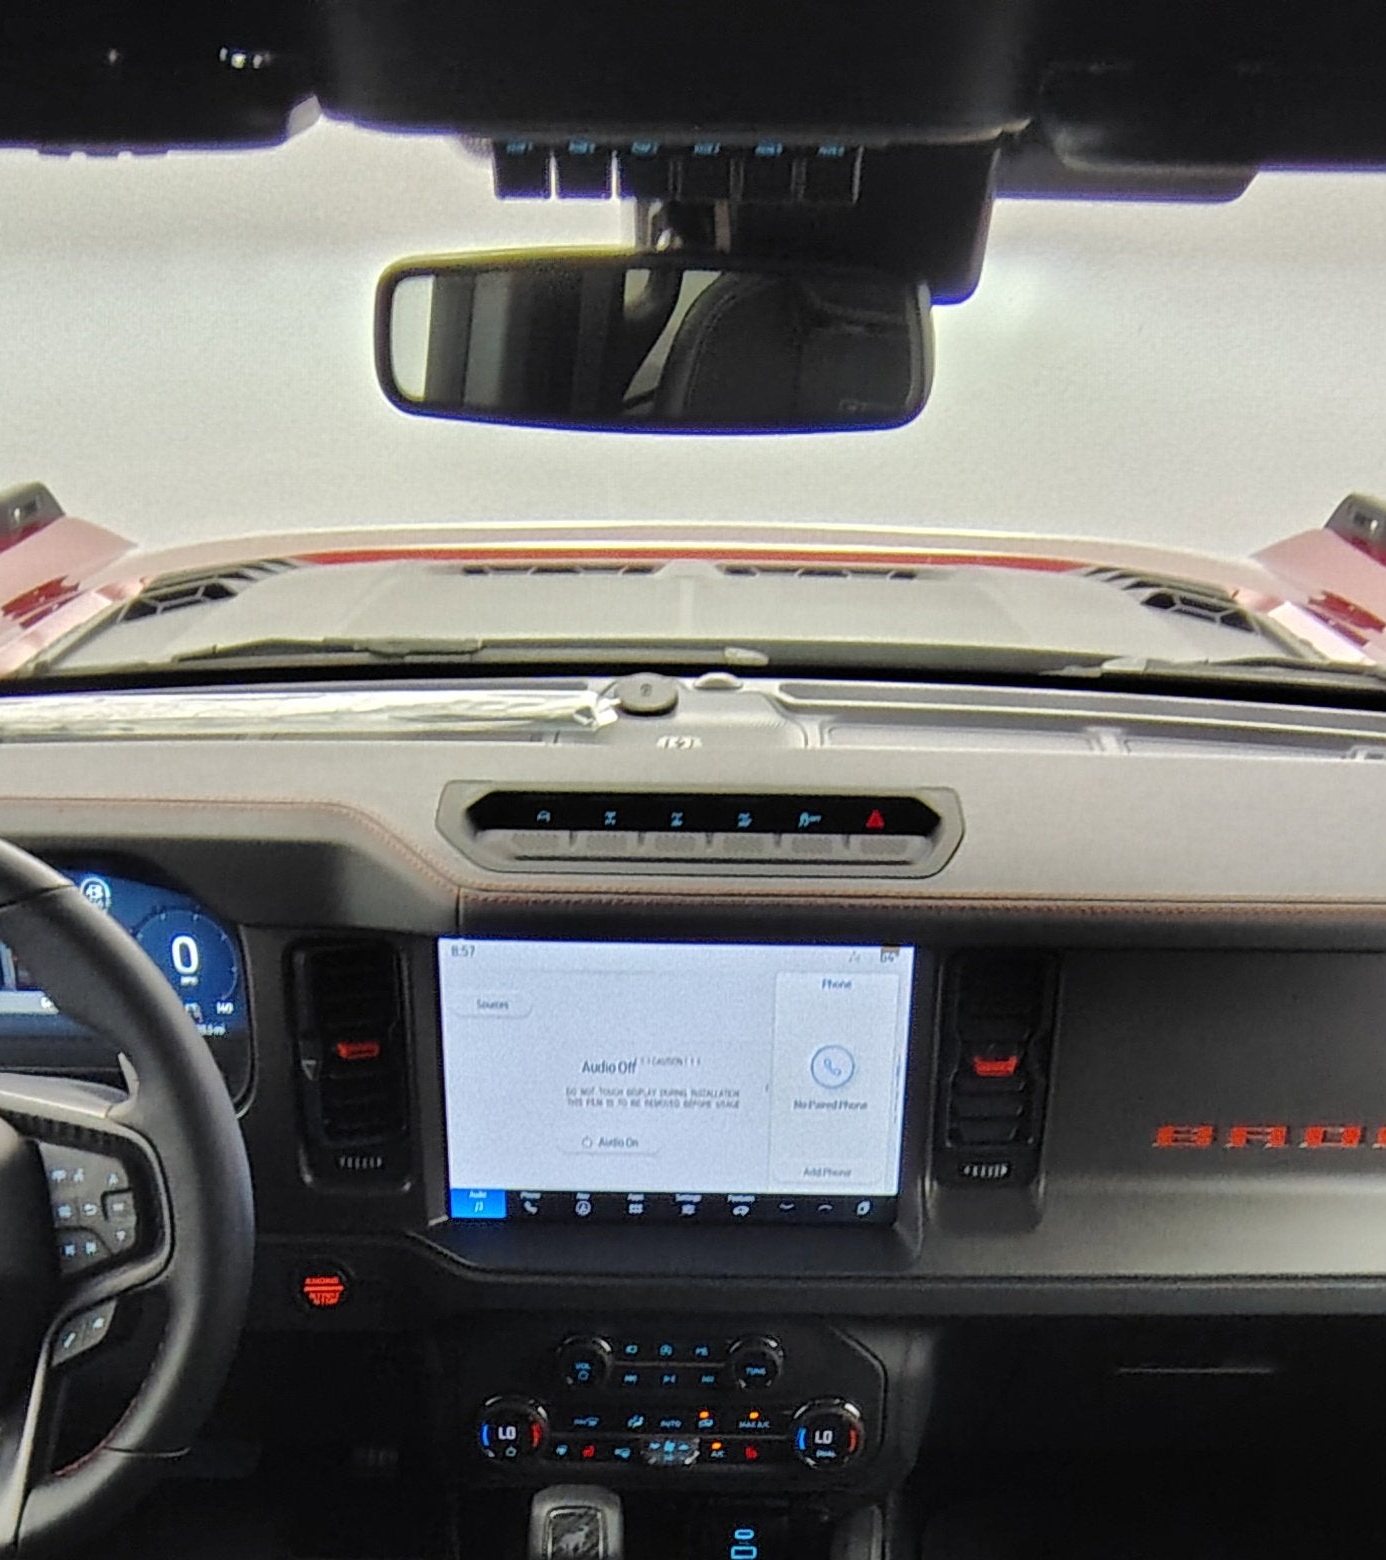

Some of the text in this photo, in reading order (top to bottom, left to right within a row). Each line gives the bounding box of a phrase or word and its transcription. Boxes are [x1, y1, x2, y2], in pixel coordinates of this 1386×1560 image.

[171, 935, 200, 975] 0
[821, 978, 853, 990] Phone
[581, 1058, 638, 1074] Audio Off
[498, 1425, 517, 1440] LO
[814, 1429, 834, 1444] LO
